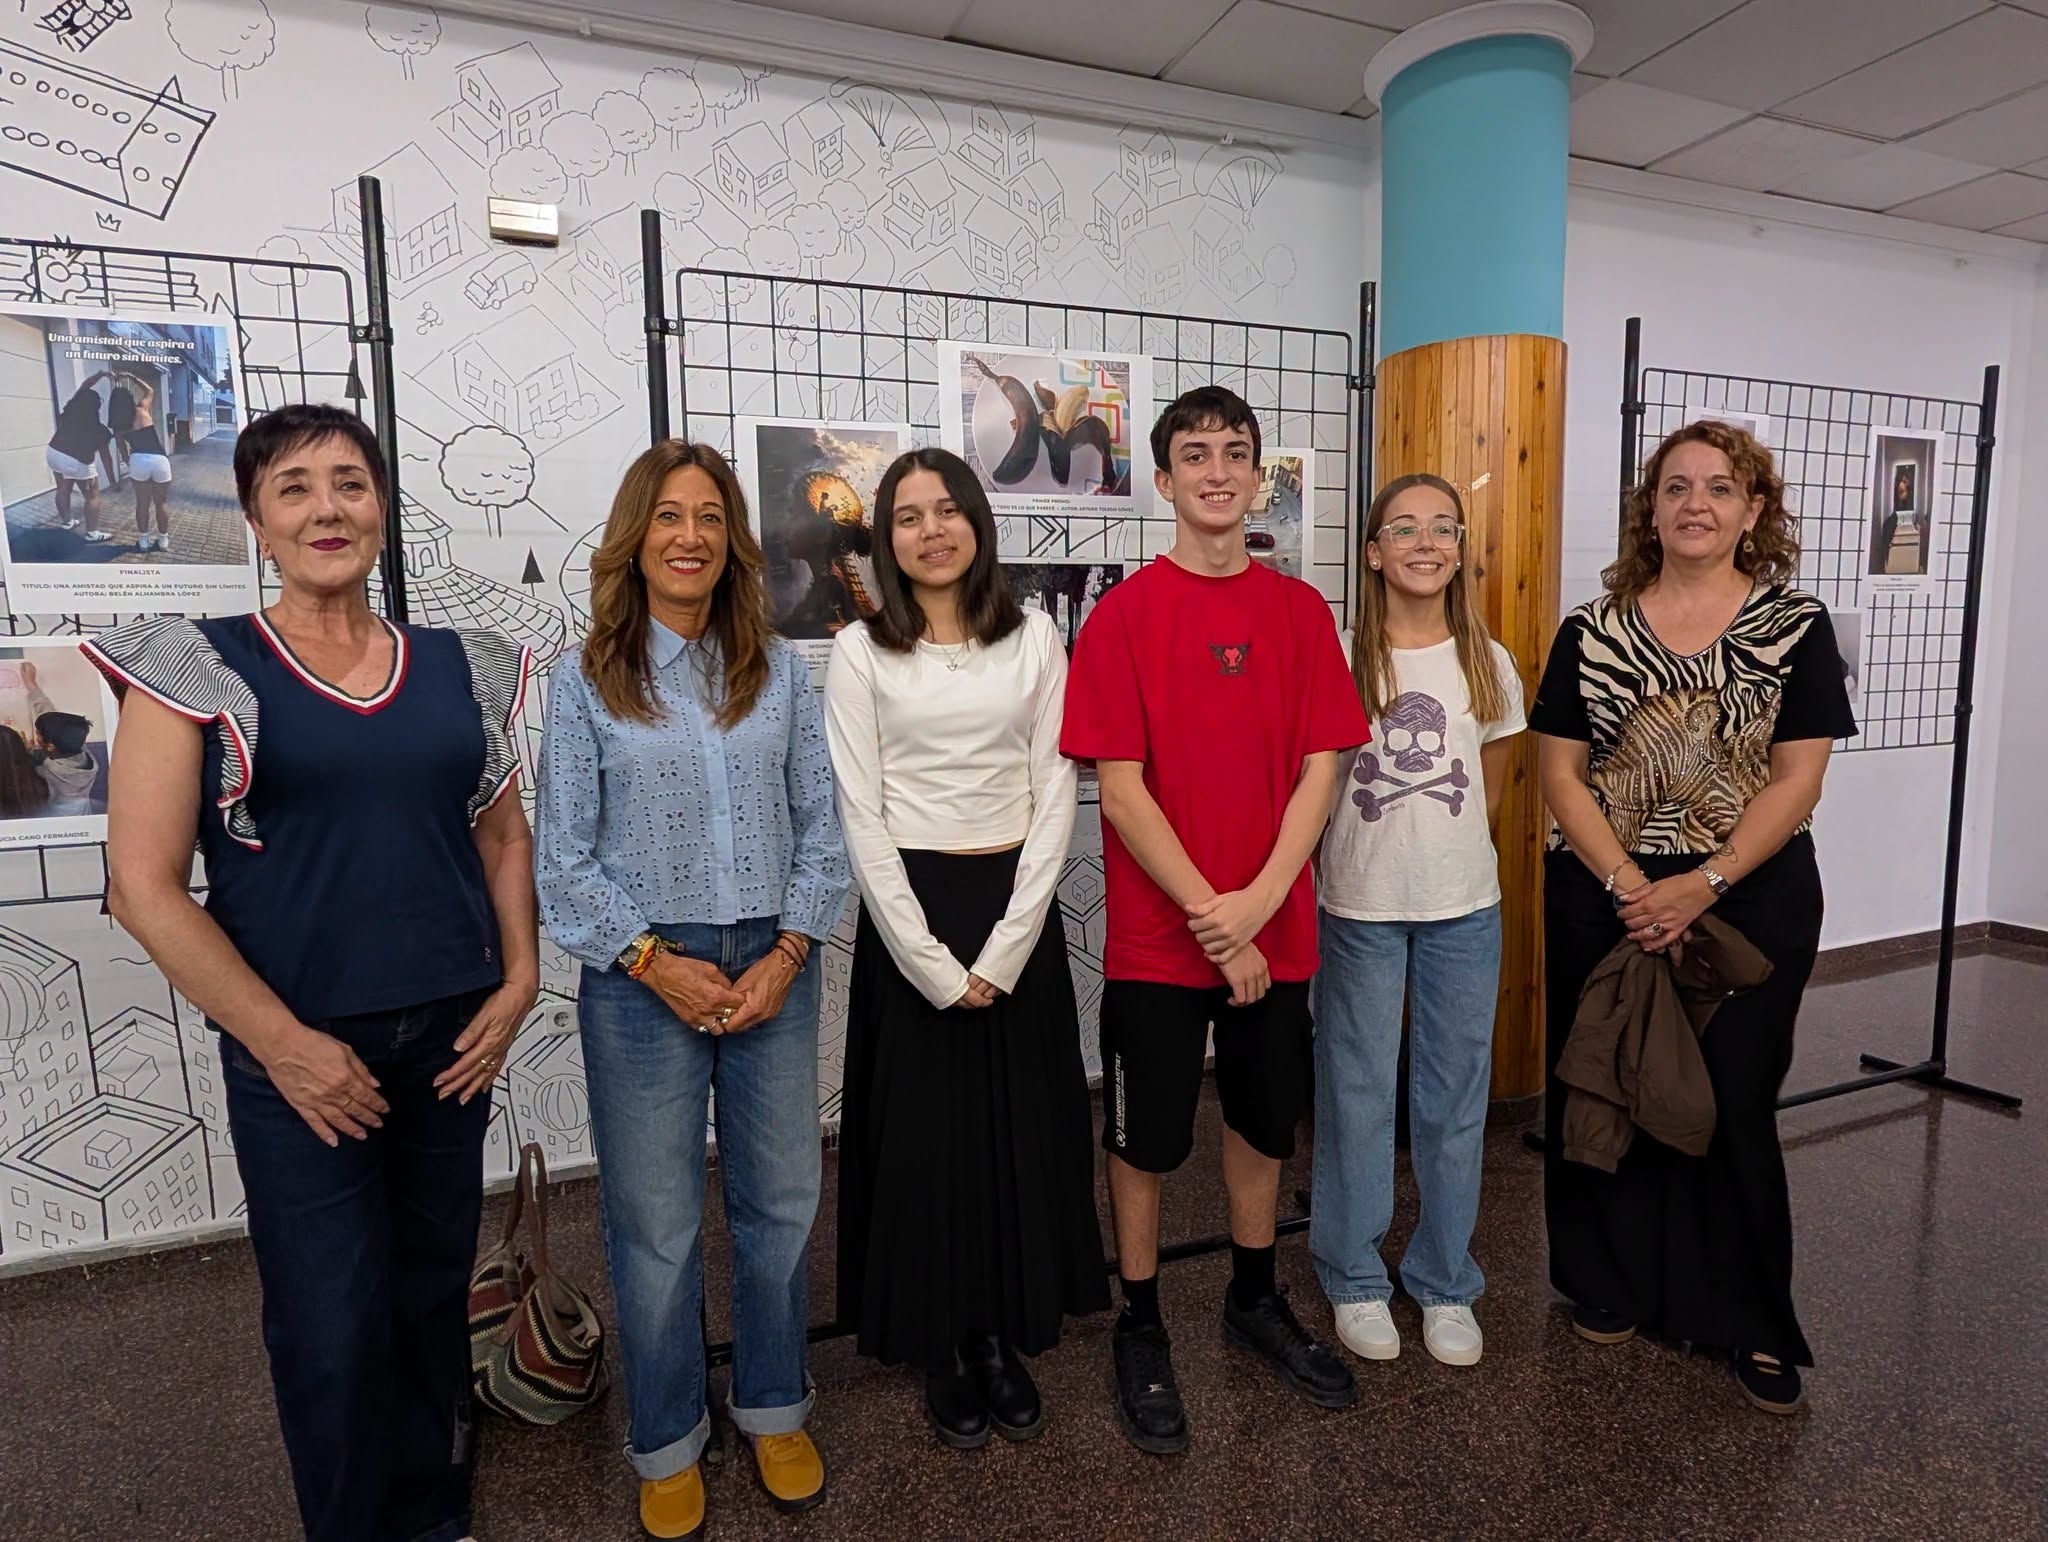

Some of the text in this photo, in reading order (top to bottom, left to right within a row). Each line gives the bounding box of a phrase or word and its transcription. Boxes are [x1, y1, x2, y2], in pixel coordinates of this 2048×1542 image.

[48, 333, 73, 343] Una
[75, 334, 122, 346] amistad
[124, 338, 146, 348] que
[147, 338, 185, 350] aspira
[65, 350, 183, 364] un futuro sin límites.
[43, 831, 90, 840] FERNÁNDEZ
